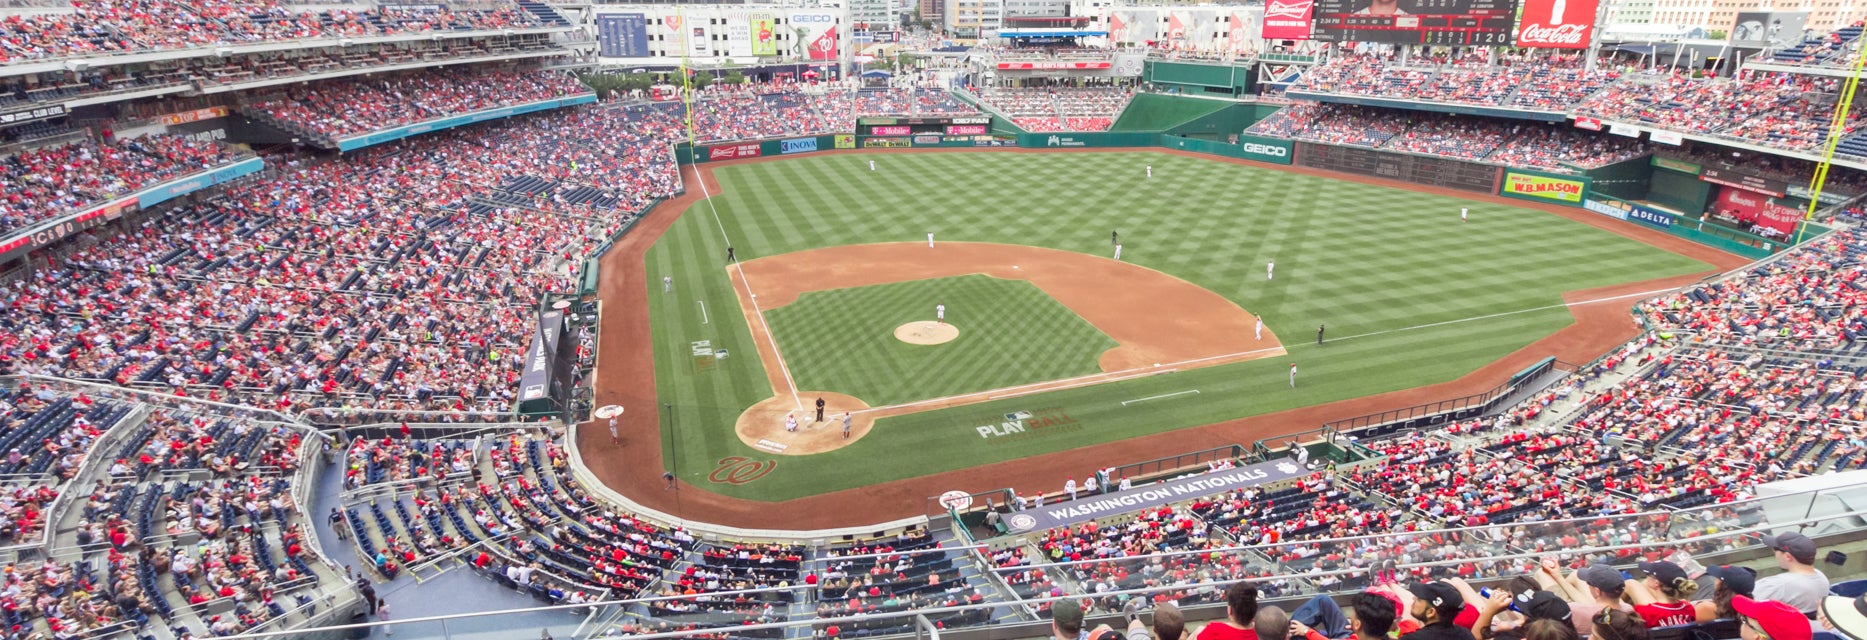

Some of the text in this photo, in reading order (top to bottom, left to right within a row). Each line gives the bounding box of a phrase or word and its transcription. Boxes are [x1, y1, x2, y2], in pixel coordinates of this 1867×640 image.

[793, 14, 830, 22] GEICO
[1475, 33, 1505, 42] 1 2 0
[1520, 24, 1588, 44] Coca-Cola
[33, 108, 48, 118] CLUB
[48, 106, 64, 115] LEVEL
[790, 140, 816, 149] INOVA
[1244, 142, 1287, 157] GEICO
[1640, 211, 1670, 225] DELTA
[976, 420, 1026, 438] PLAY
[1048, 468, 1268, 520] WASHINGTON NATIONALS
